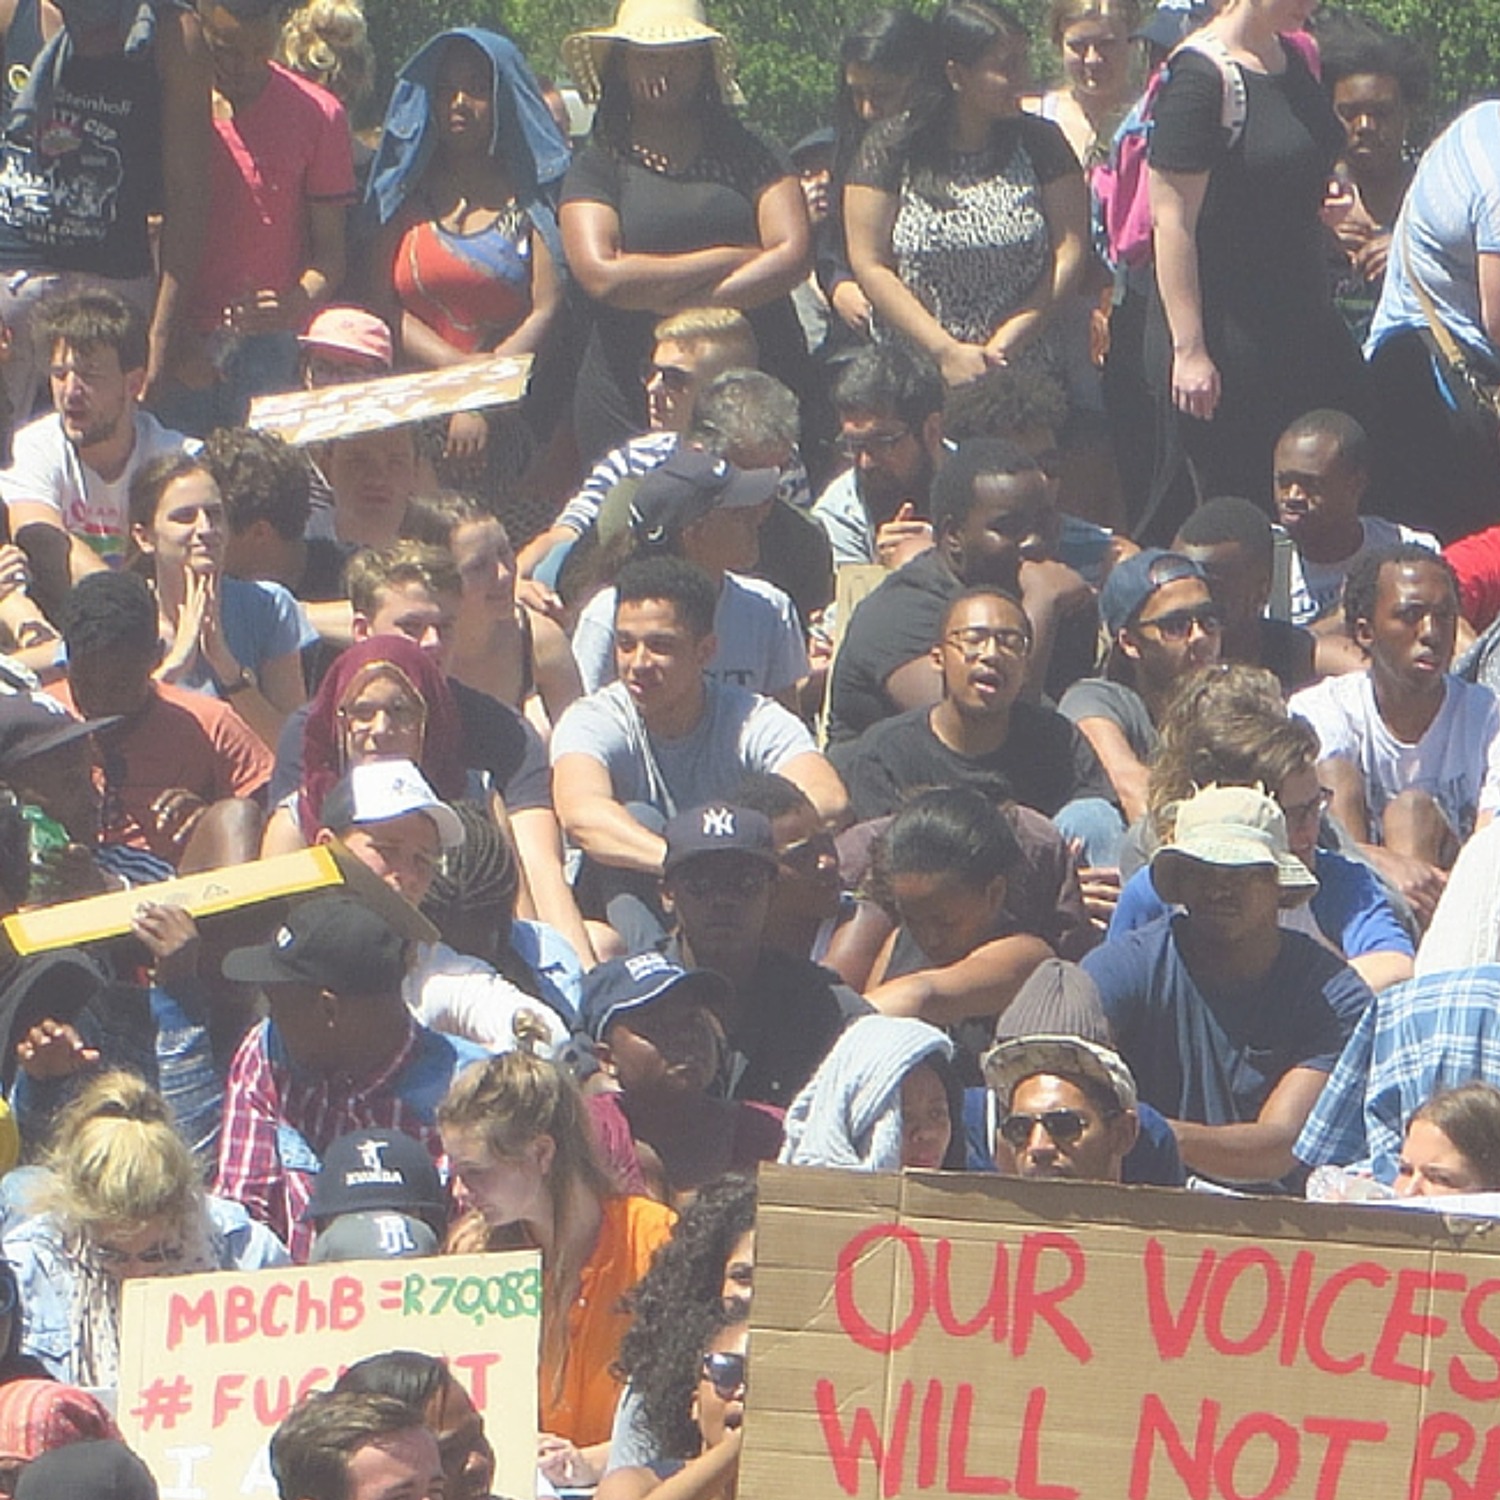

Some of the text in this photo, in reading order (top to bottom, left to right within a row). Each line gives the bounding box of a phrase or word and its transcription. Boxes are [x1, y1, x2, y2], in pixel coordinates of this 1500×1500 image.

[166, 1276, 366, 1351] MBChB
[833, 1223, 1094, 1366] OUR
[161, 1442, 213, 1500] I
